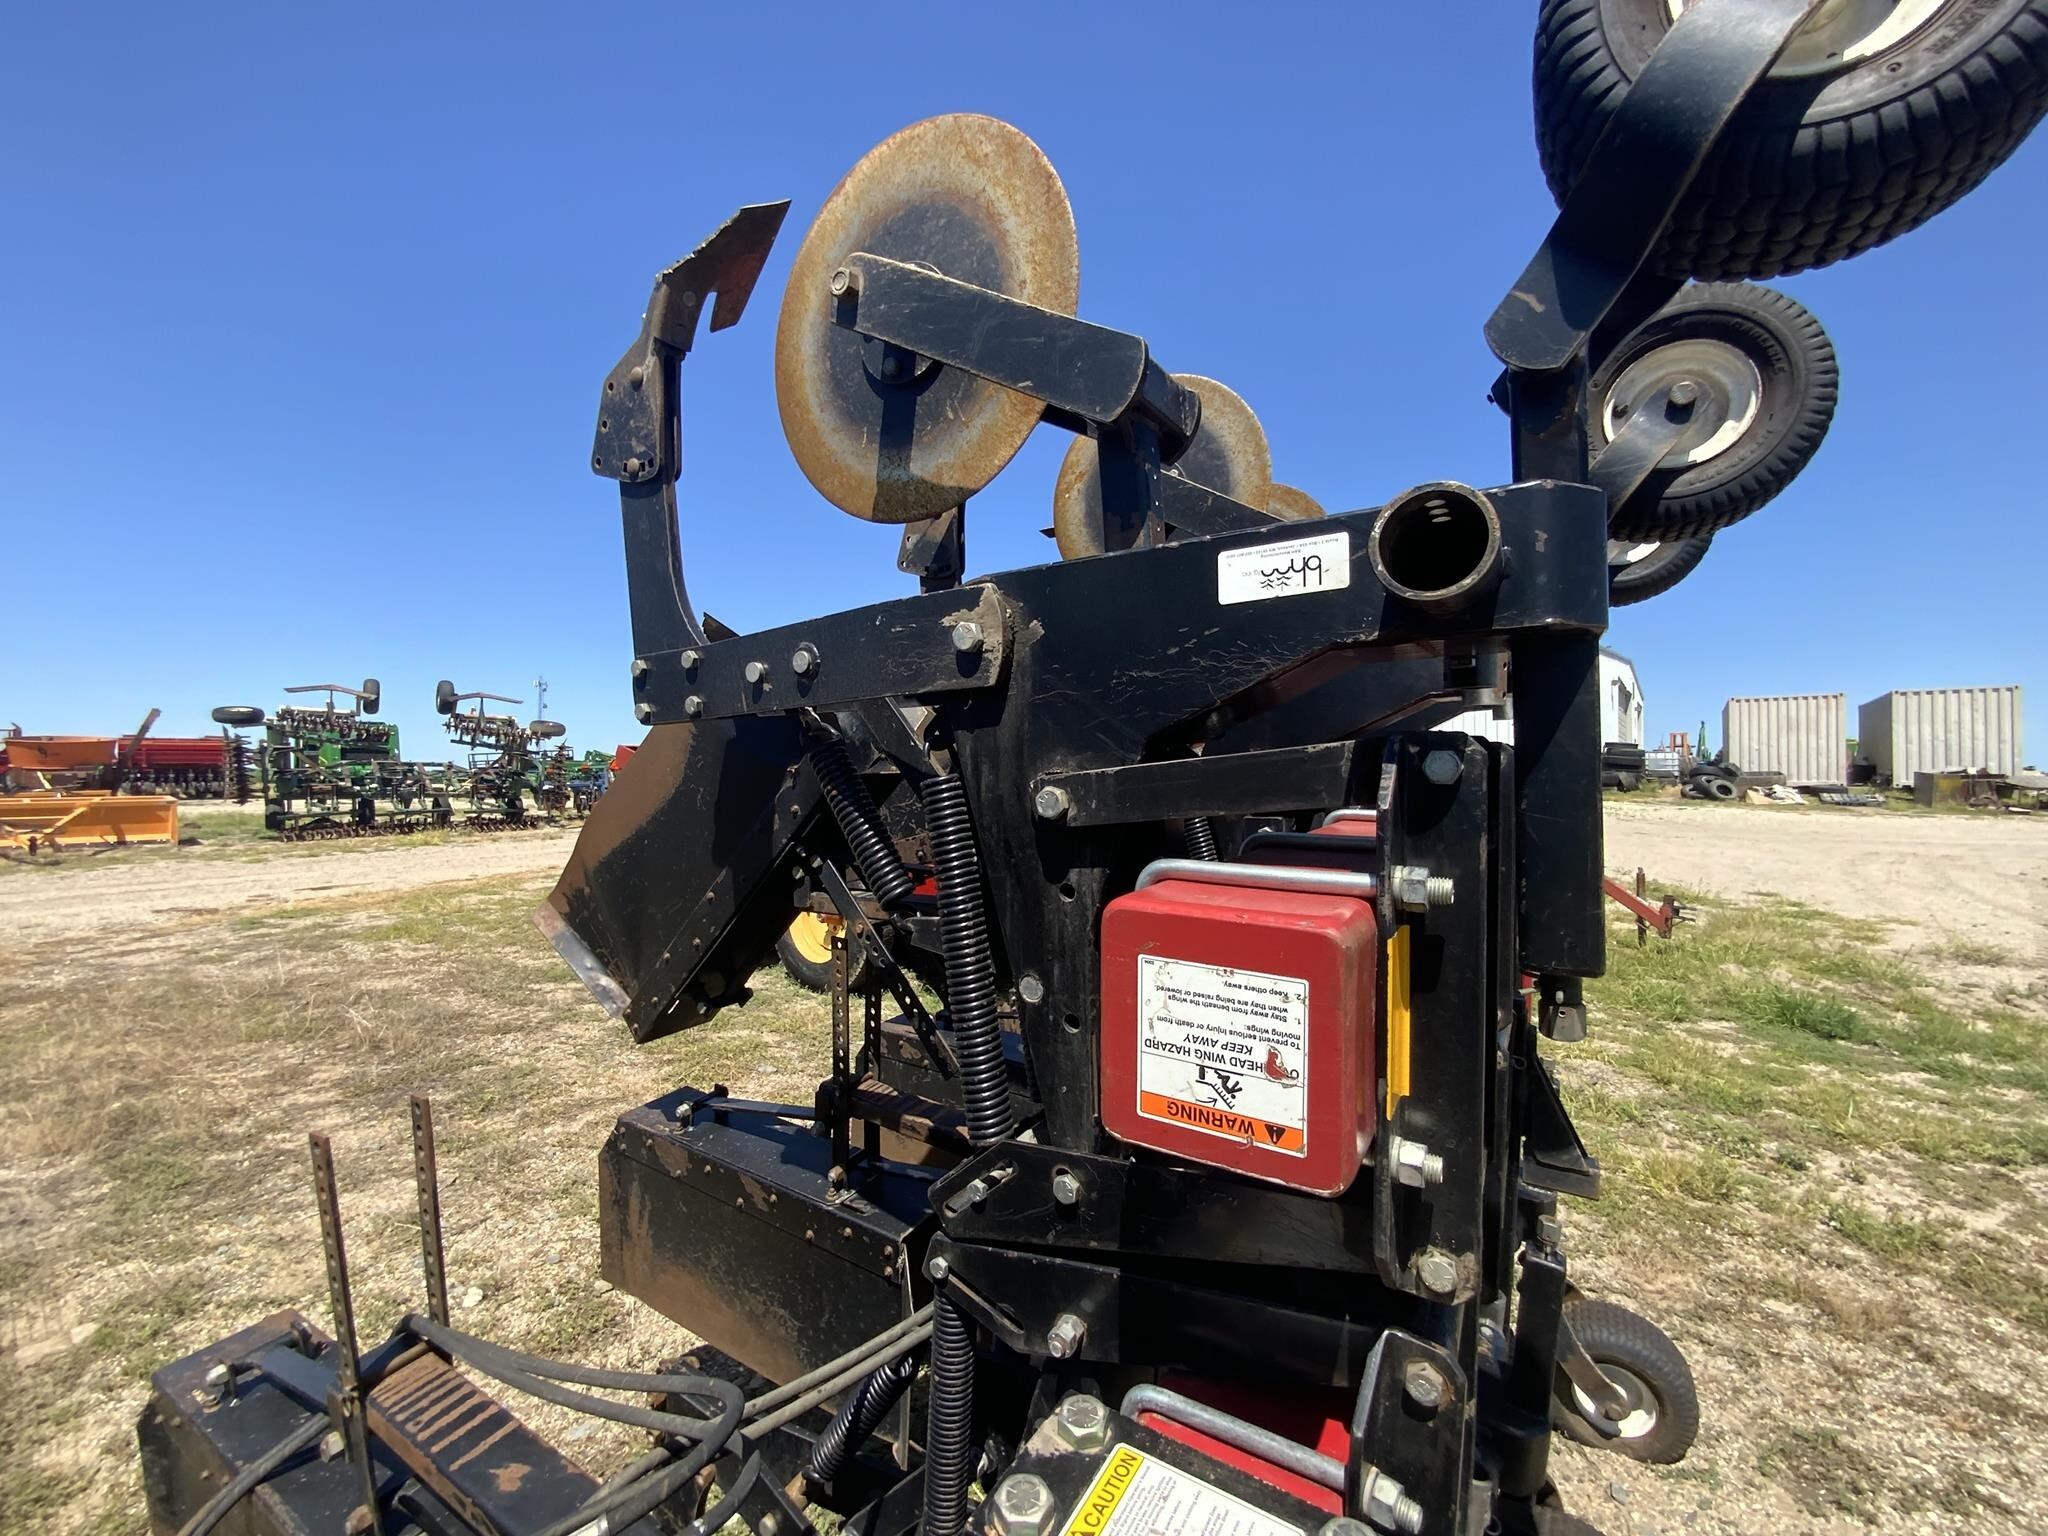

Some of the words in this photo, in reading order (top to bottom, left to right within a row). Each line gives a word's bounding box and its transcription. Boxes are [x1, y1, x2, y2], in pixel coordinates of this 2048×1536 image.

[1244, 986, 1267, 994] others
[1269, 989, 1288, 999] Keep
[1168, 994, 1187, 1003] wings
[1193, 992, 1214, 1000] raised
[1216, 995, 1235, 1005] being
[1202, 1002, 1230, 1012] beneath
[1250, 1001, 1266, 1010] they
[1232, 1007, 1248, 1015] from
[1250, 1009, 1268, 1018] away
[1156, 1016, 1173, 1024] from
[1271, 1013, 1287, 1022] Stay
[1175, 1019, 1194, 1028] death
[1206, 1024, 1226, 1035] injury
[1272, 1029, 1300, 1040] moving
[1229, 1030, 1256, 1040] serious
[1183, 1034, 1218, 1047] AWAY
[1259, 1036, 1288, 1046] prevent
[1144, 1039, 1190, 1056] HAZARD
[1221, 1042, 1252, 1055] KEEP
[1290, 1042, 1301, 1050] To
[1195, 1049, 1225, 1064] WING
[1167, 1101, 1255, 1136] WARNING
[1084, 1452, 1139, 1528] CAUTION
